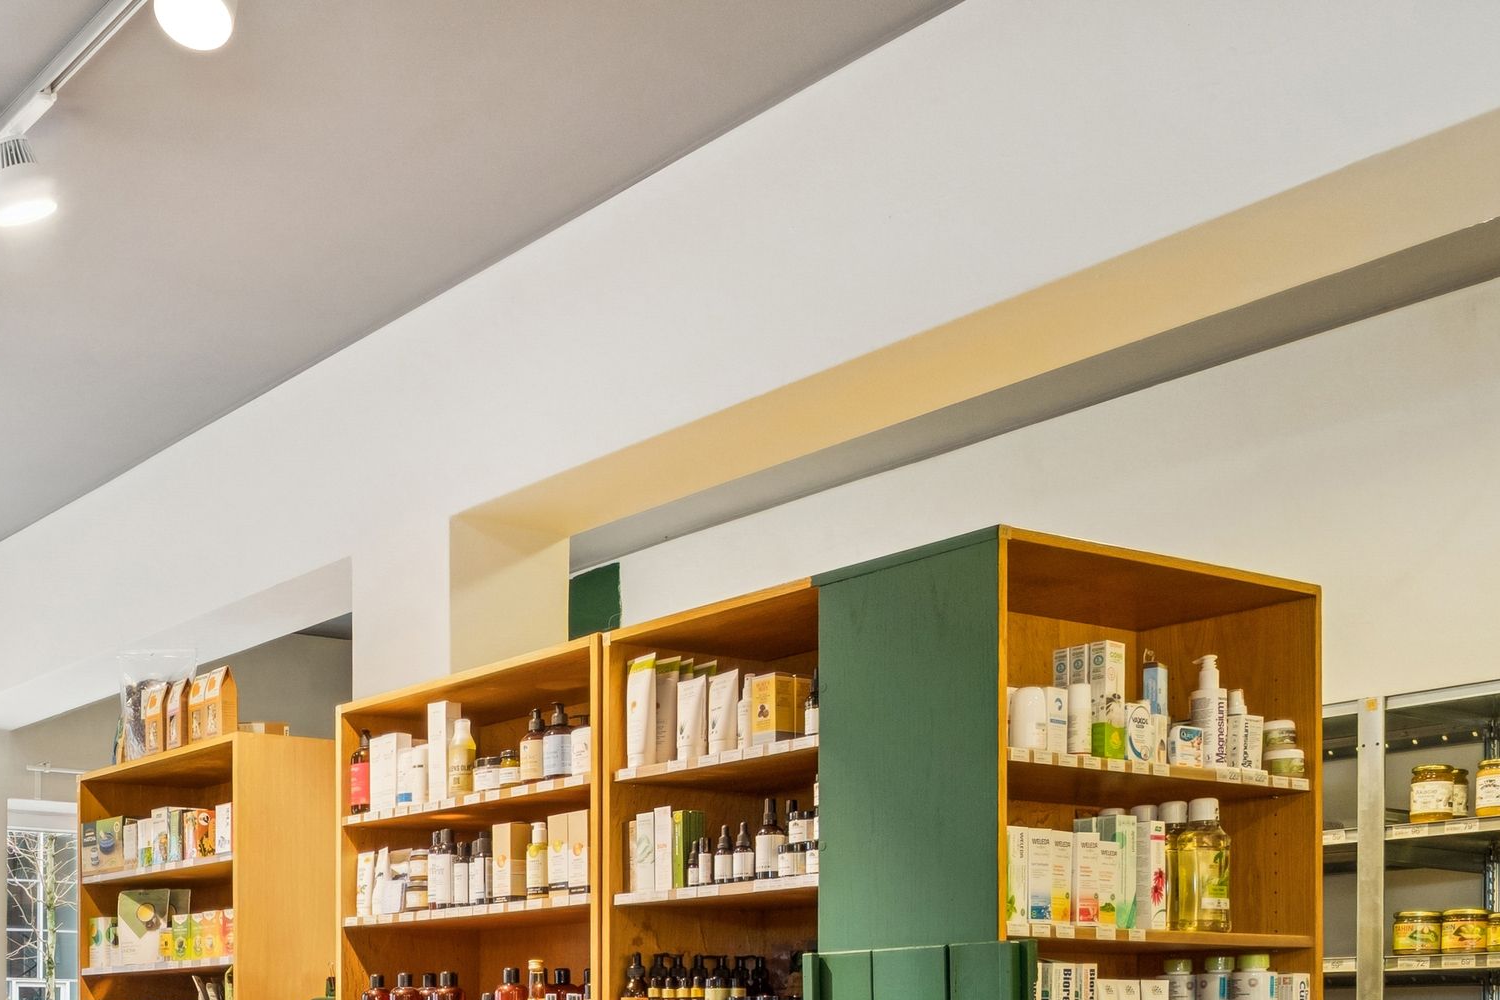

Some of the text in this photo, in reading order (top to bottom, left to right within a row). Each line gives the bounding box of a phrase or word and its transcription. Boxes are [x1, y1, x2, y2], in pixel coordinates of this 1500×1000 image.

[1214, 700, 1226, 764] Magnesium
[1031, 837, 1050, 846] WELEDA
[1054, 840, 1071, 849] WELEDA
[1081, 841, 1098, 849] WELEDA
[1101, 849, 1118, 857] WELEDA
